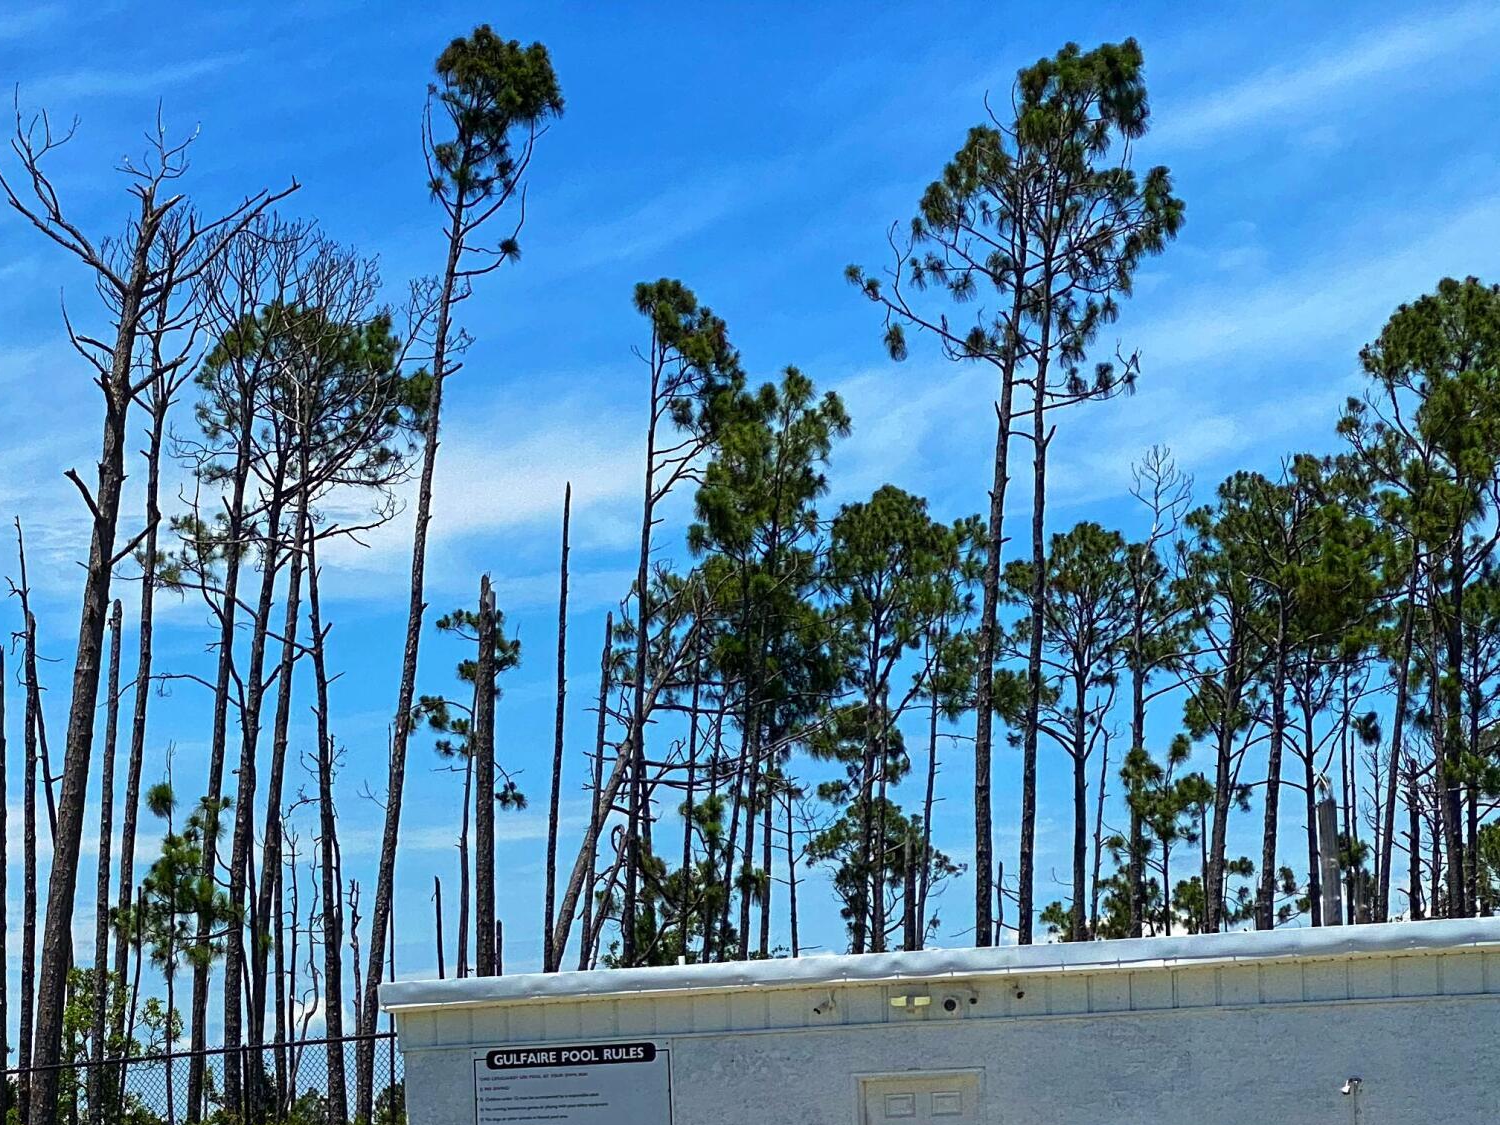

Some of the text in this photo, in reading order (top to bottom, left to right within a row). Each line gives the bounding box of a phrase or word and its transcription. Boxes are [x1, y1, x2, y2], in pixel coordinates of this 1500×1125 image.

[494, 1047, 644, 1066] GULFAIRE POOL RULES
